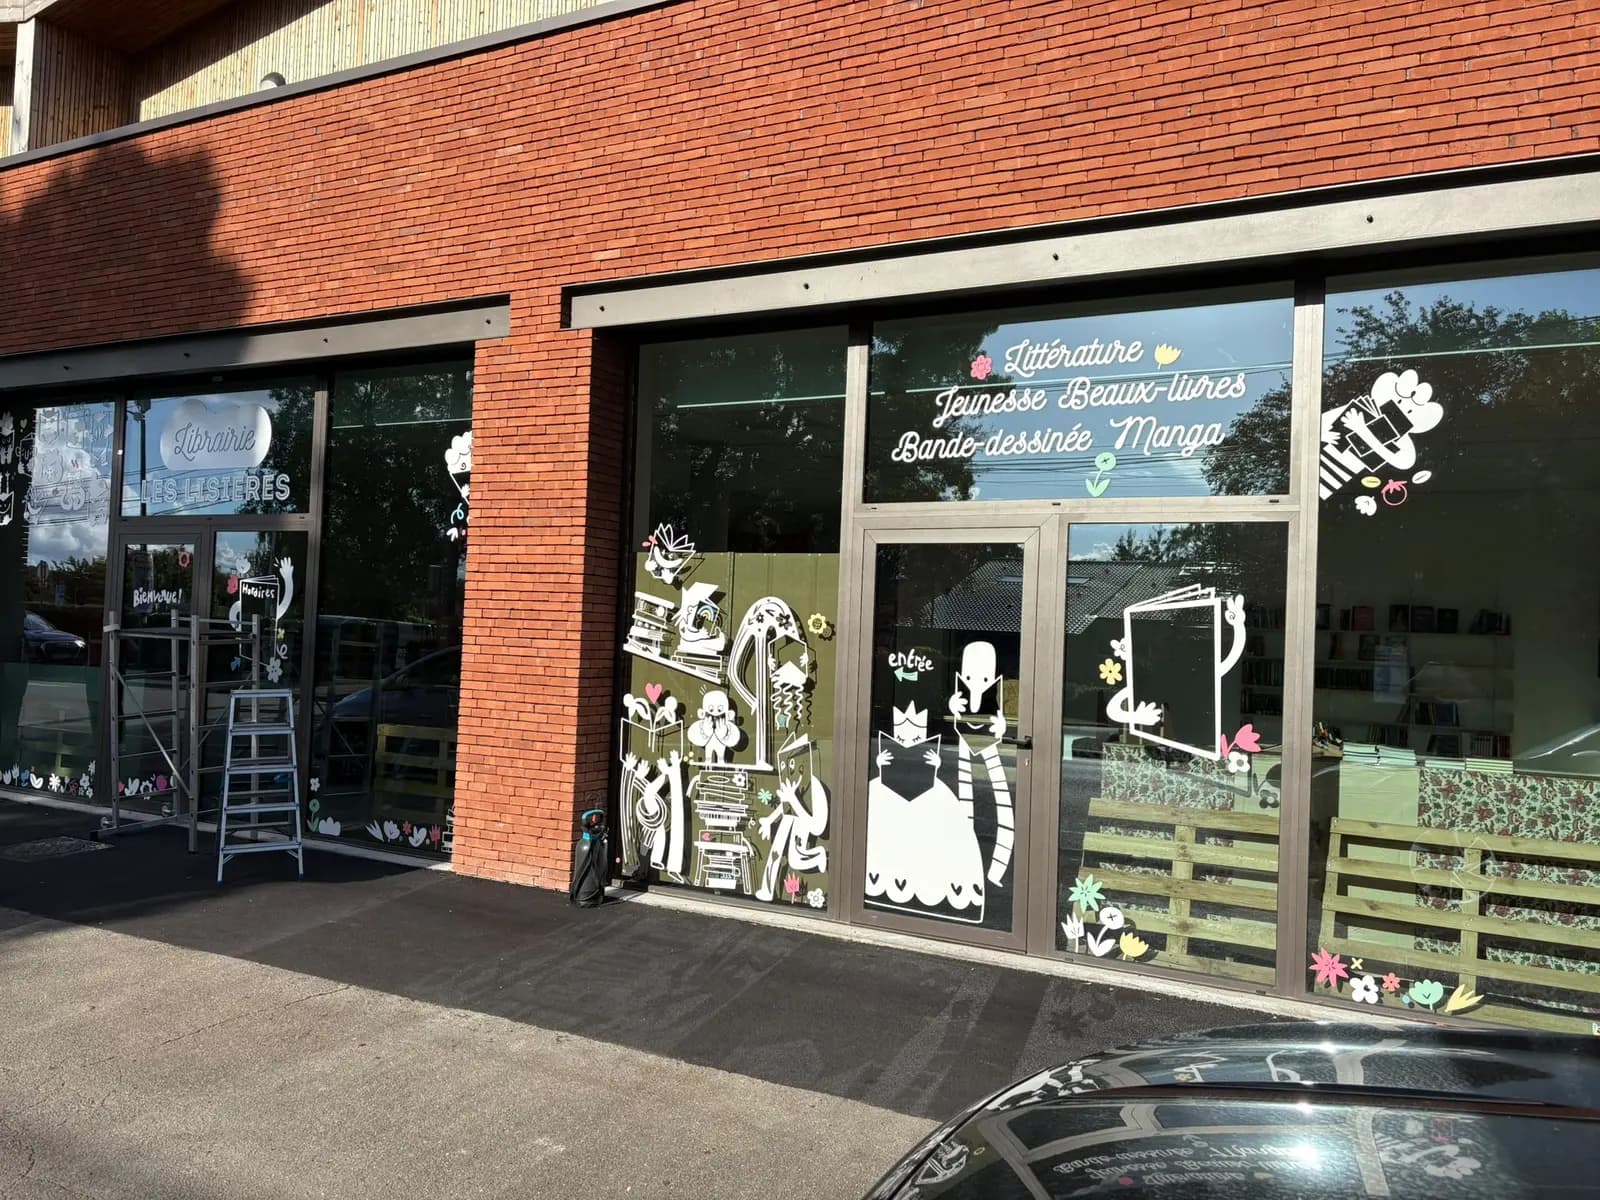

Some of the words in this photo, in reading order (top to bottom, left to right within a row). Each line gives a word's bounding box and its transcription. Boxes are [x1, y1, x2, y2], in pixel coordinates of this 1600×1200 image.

[1005, 338, 1144, 377] Littérature
[932, 387, 1047, 428] Jeunesse
[1058, 373, 1246, 411] Beaux-livres
[174, 422, 256, 462] Librairie
[891, 424, 1093, 463] Bande-dessinée
[1110, 416, 1226, 457] Manga
[141, 479, 177, 503] LES
[242, 583, 275, 599] Horaires
[888, 648, 934, 672] entrée
